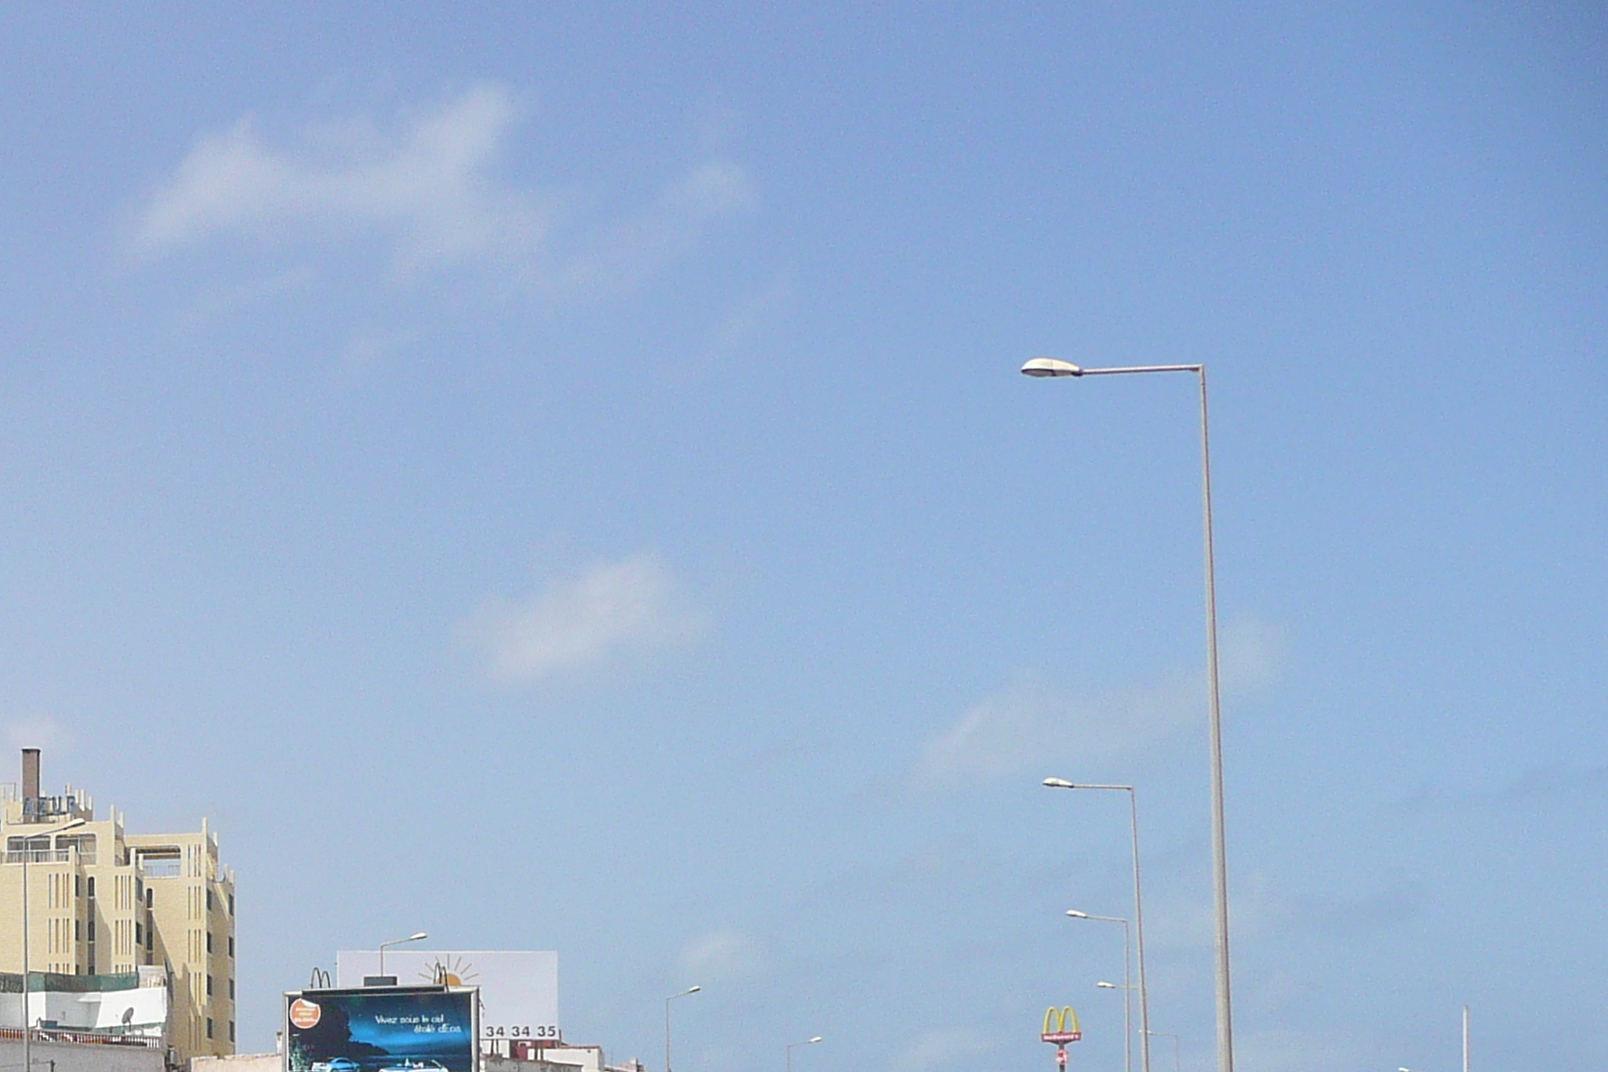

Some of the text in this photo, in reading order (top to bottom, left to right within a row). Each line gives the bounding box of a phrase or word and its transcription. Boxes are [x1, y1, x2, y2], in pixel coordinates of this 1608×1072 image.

[486, 1025, 556, 1037] 34 34 35
